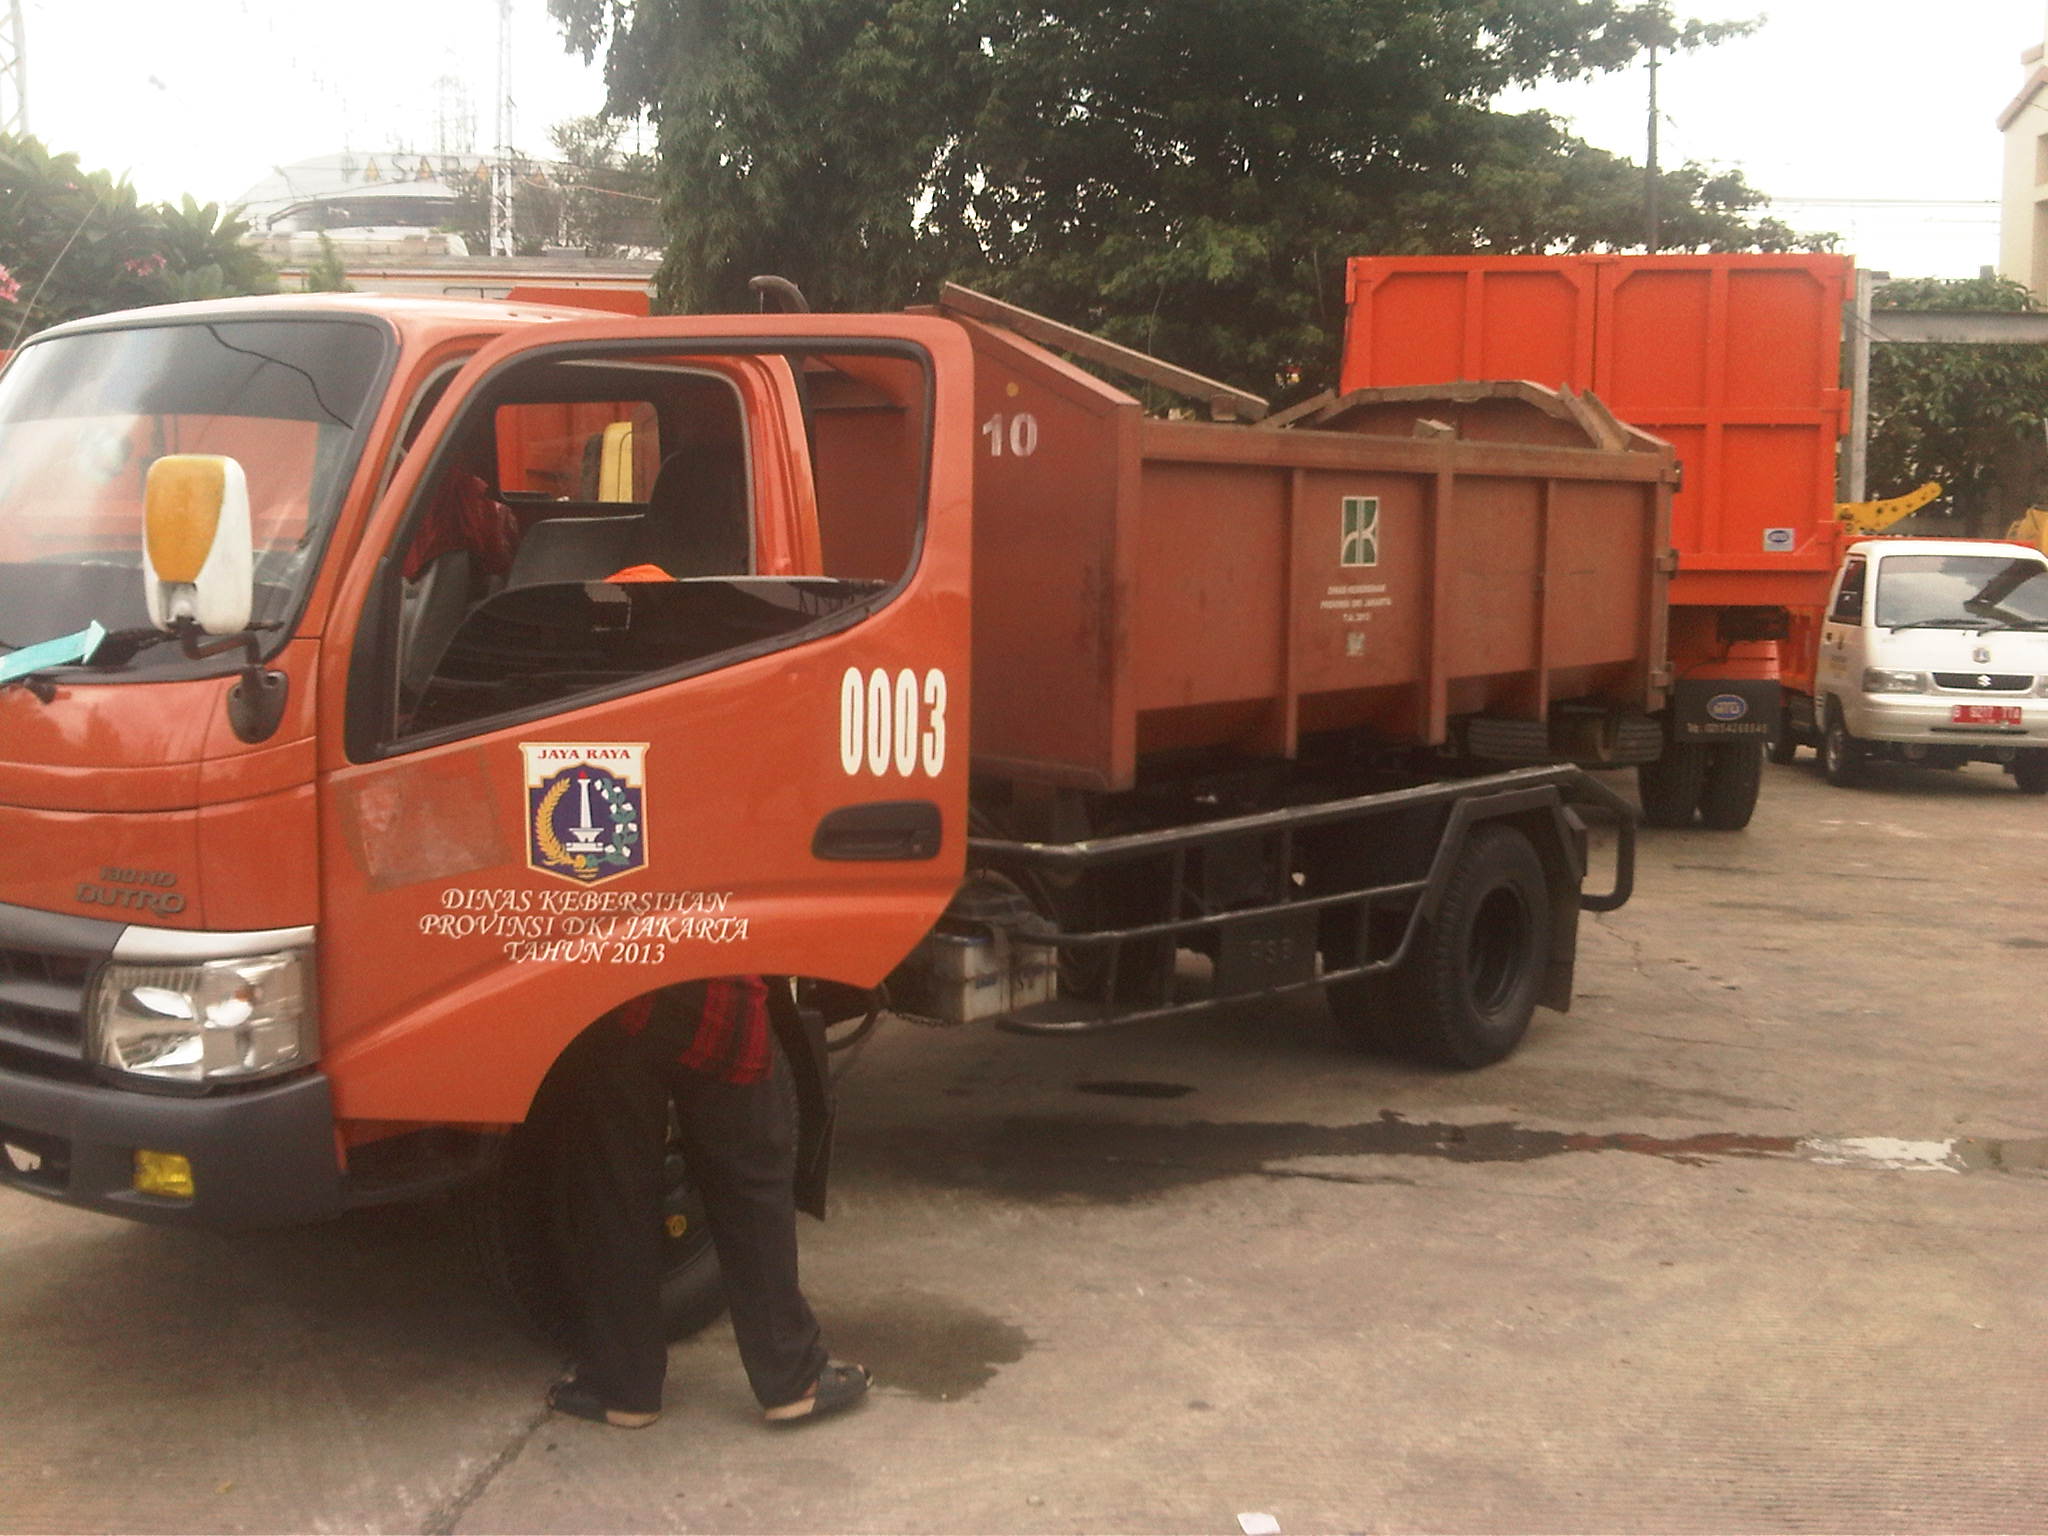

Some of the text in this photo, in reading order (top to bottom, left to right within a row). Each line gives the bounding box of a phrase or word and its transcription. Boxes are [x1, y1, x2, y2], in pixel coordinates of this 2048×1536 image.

[983, 412, 1038, 457] 10
[841, 666, 947, 777] 0003
[538, 749, 630, 760] JAYA RAYA
[76, 884, 185, 915] DUTRO
[442, 888, 733, 915] DINAS KEBERSIHAN
[419, 912, 749, 943] PROVINSI DKI JAKARTA
[504, 939, 665, 964] TAHUN 2013
